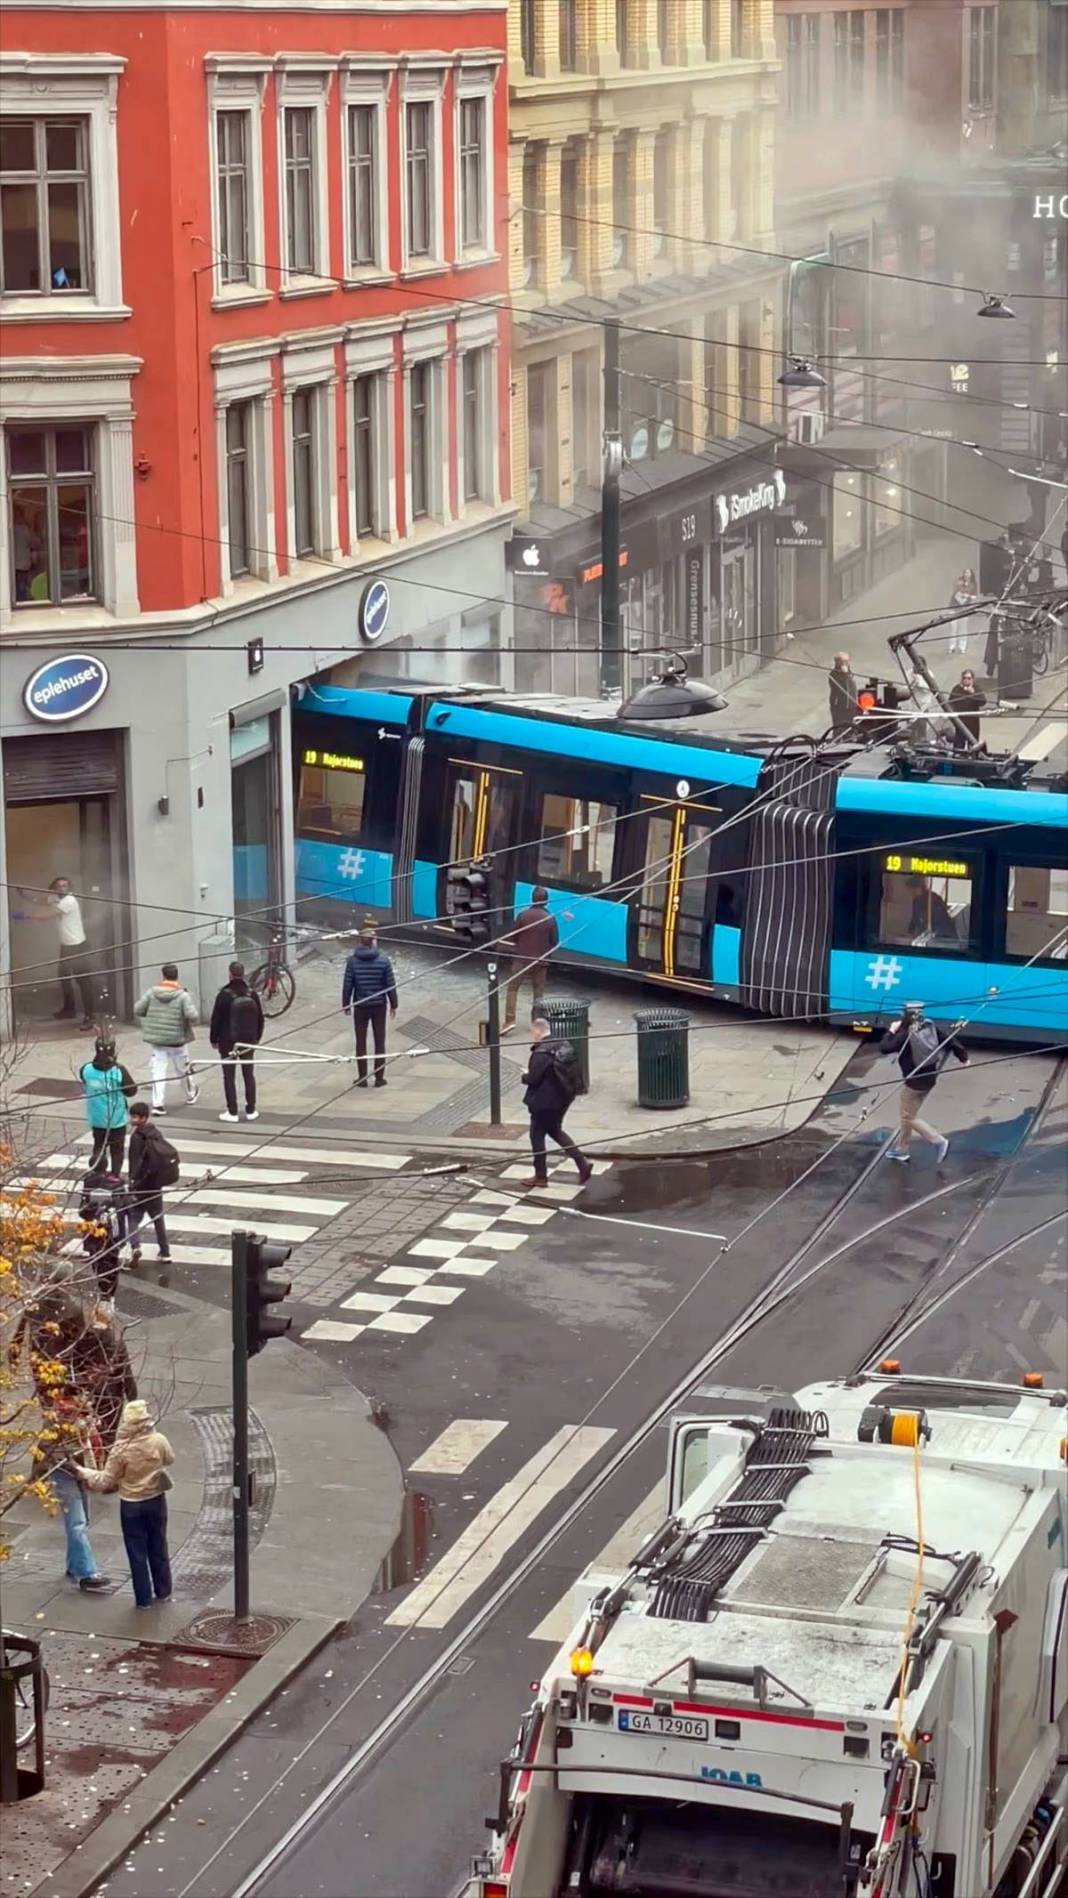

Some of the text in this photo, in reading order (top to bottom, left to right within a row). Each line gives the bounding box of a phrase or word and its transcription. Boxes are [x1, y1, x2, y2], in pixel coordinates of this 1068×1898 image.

[33, 665, 99, 704] eplehuset
[886, 855, 966, 874] 19 Majorstuen
[632, 1714, 703, 1736] GA 12906
